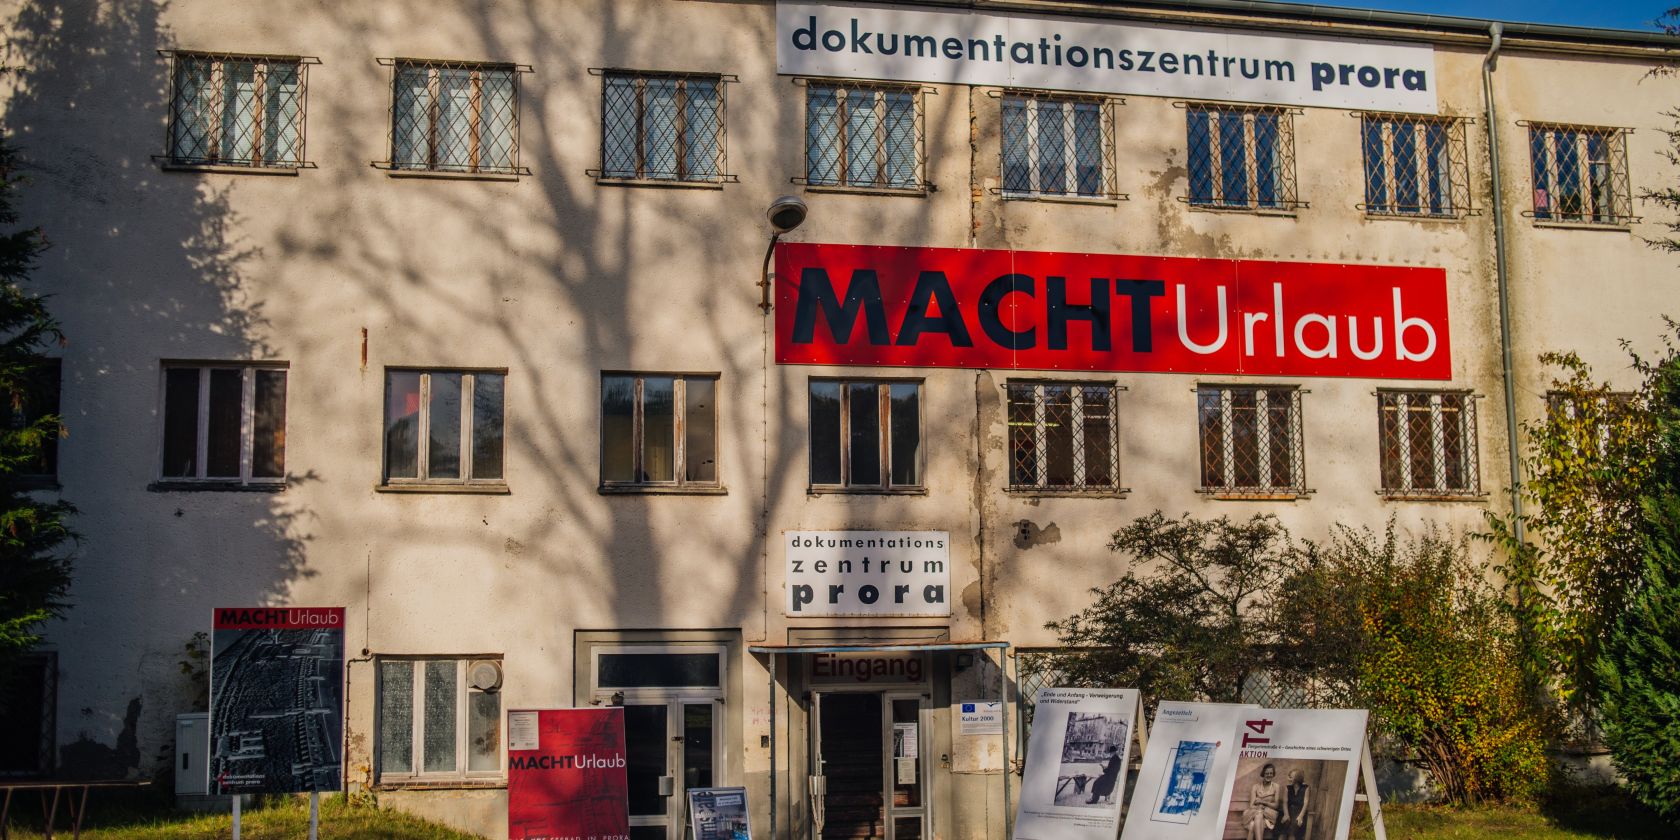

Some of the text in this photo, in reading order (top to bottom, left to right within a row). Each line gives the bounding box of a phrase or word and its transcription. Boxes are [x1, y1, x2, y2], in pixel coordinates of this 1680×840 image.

[791, 16, 1427, 91] dokumentationszentrum prora
[792, 536, 944, 549] dokumentations
[792, 557, 944, 573] zentrum
[792, 584, 945, 611] prora
[812, 653, 922, 682] Eingang
[1241, 718, 1274, 748] T4
[1239, 750, 1268, 758] AKTION
